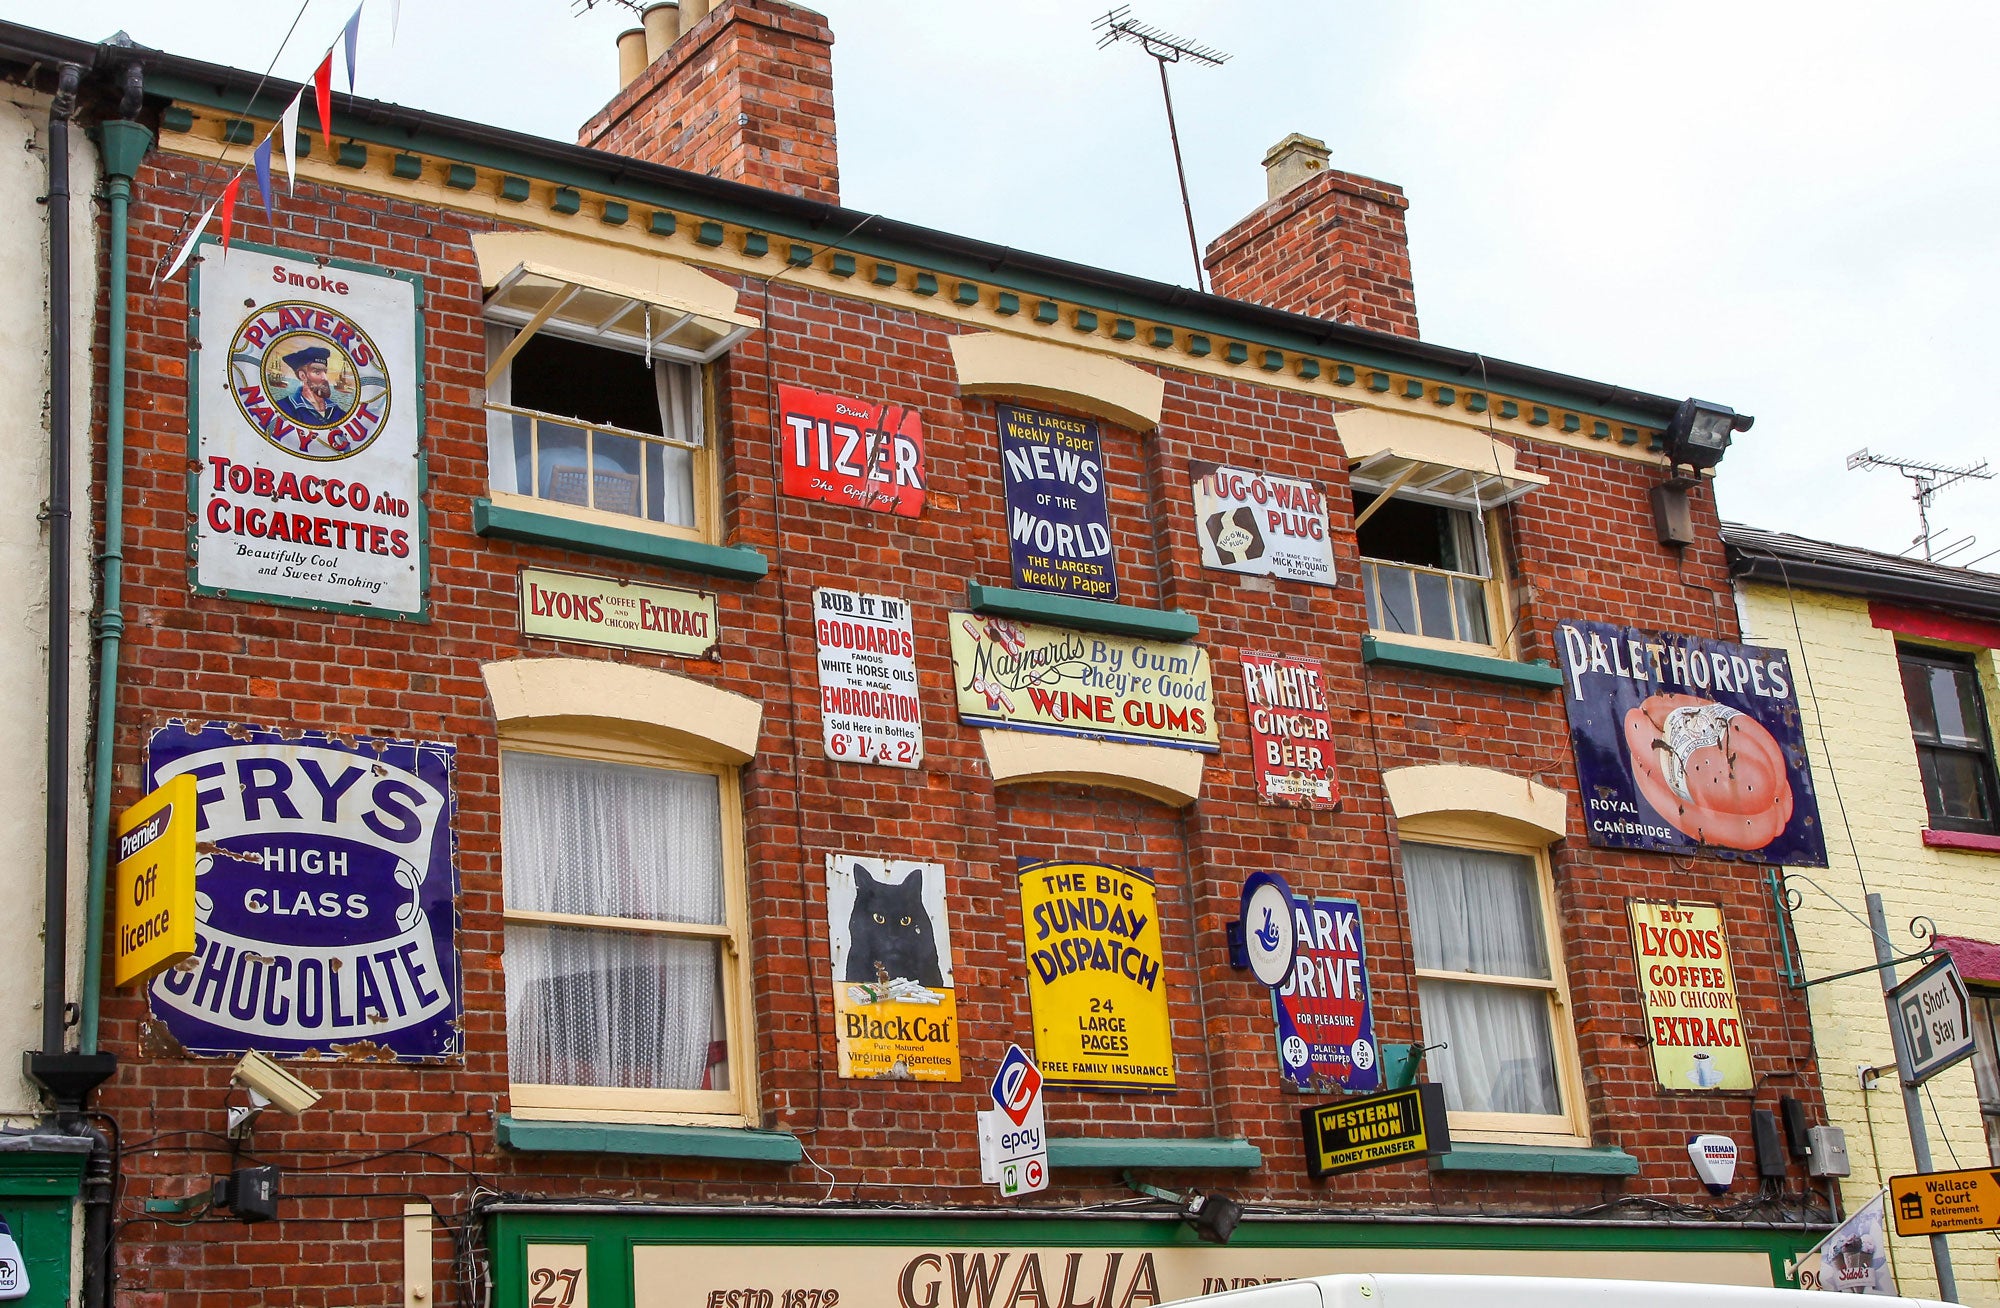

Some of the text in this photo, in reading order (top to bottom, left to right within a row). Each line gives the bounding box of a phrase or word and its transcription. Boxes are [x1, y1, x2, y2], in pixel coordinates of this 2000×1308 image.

[272, 265, 349, 296] Smoke
[244, 306, 375, 368] PLAYER'S
[239, 385, 379, 453] NAVY CUT
[836, 404, 870, 420] Drink
[1012, 410, 1086, 434] THE LARGEST
[1007, 423, 1094, 452] Weekly Paper
[786, 412, 924, 490] TIZER
[1005, 445, 1100, 494] NEWS
[208, 455, 410, 518] TOBACCO AND
[810, 478, 902, 504] The Appeize
[1036, 494, 1078, 510] OF THE
[206, 497, 410, 558] CIGARETTES
[1012, 506, 1110, 558] WORLD
[1267, 510, 1322, 540] PLUG
[258, 565, 278, 576] and
[282, 566, 324, 583] Sweet
[310, 554, 338, 568] Cool
[1027, 555, 1104, 576] THE LARGEST
[1288, 568, 1314, 577] PEOPLE
[1022, 568, 1112, 595] Weekly Paper
[530, 582, 708, 638] LYONS' EXTRACT
[606, 596, 636, 608] COFFEE
[820, 592, 904, 620] RUB IT IN!
[604, 618, 640, 631] CHICORY
[818, 618, 912, 658] GODDARD'S
[821, 659, 914, 682] WHITE HORSE OILS
[852, 653, 883, 664] FAMOUS
[964, 632, 1200, 692] Maynards By Gum!
[1562, 624, 1788, 700] PALETHORPES'
[847, 678, 892, 690] THE MAGIC
[1081, 666, 1207, 701] they're Good
[822, 685, 919, 724] EMBROCATION
[1029, 688, 1116, 724] WINE
[1124, 700, 1207, 734] GUMS
[831, 719, 914, 738] Sold Here in Bottles
[1254, 710, 1330, 741] GINGER
[878, 742, 892, 760] &
[1266, 740, 1323, 770] BEER
[1288, 786, 1316, 794] SUPPER
[1590, 798, 1638, 814] ROYAL
[121, 818, 160, 860] Premier
[1594, 820, 1672, 840] CAMBRIDGE
[264, 846, 348, 876] HIGH
[134, 864, 158, 907] Off
[1042, 873, 1134, 900] THE BIG
[244, 888, 369, 918] CLASS
[1033, 898, 1148, 942] SUNDAY
[1660, 910, 1694, 923] BUY
[122, 909, 170, 957] licence
[1296, 908, 1358, 952] ARK
[1638, 922, 1723, 960] LYONS'
[1030, 938, 1160, 992] DISPATCH
[1650, 965, 1726, 988] COFFEE
[1090, 998, 1114, 1014] 24
[1650, 990, 1734, 1010] AND CHICORY
[1078, 1016, 1126, 1033] LARGE
[1297, 1013, 1355, 1027] FOR PLEASURE
[1652, 1016, 1742, 1048] EXTRACT
[1906, 982, 1950, 1058] P Short
[1932, 1019, 1955, 1046] Stay
[894, 1044, 924, 1052] Matured
[1082, 1034, 1128, 1051] PAGES
[1290, 1038, 1300, 1048] 10
[1359, 1042, 1365, 1052] 5
[848, 1052, 952, 1066] Virginia Cigarettes
[1042, 1062, 1168, 1077] FREE FAMILY INSURANCE
[1311, 1054, 1350, 1063] CORK TIPPED
[1322, 1102, 1399, 1132] WESTERN
[1002, 1128, 1040, 1154] epay
[1348, 1120, 1402, 1144] UNION
[1331, 1140, 1416, 1165] MONEY TRANSFER
[1926, 1180, 1977, 1192] Wallace
[1934, 1192, 1972, 1205] Court
[1930, 1204, 1980, 1216] Retirement
[1930, 1217, 1984, 1228] Apartments
[530, 1268, 582, 1308] 27
[898, 1252, 1162, 1308] GWALIA
[781, 1289, 840, 1308] 1872
